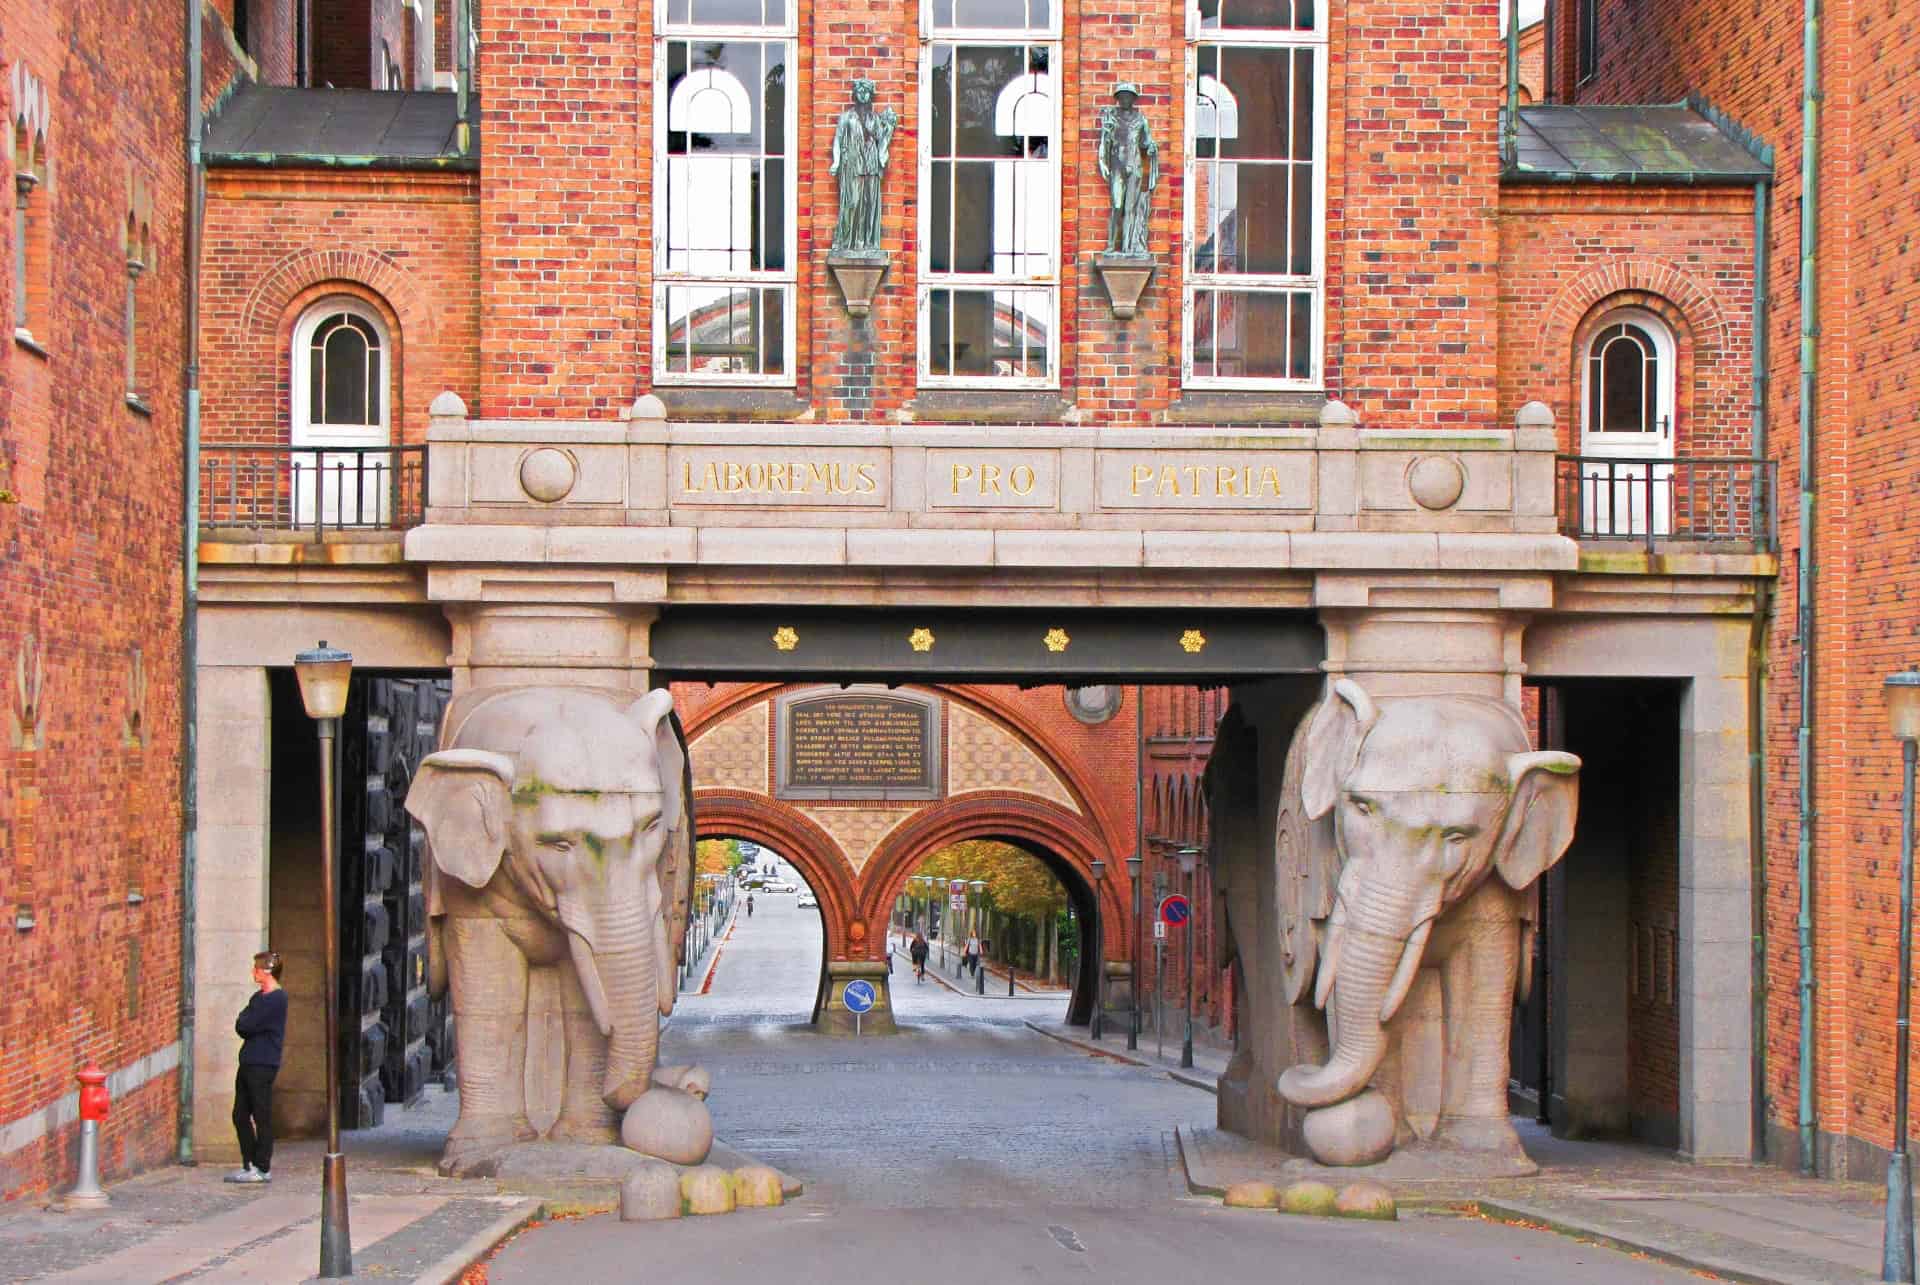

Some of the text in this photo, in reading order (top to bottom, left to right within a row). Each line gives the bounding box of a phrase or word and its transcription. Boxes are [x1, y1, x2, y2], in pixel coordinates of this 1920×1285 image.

[683, 461, 1281, 497] LABOREMUS PRO PATRIA
